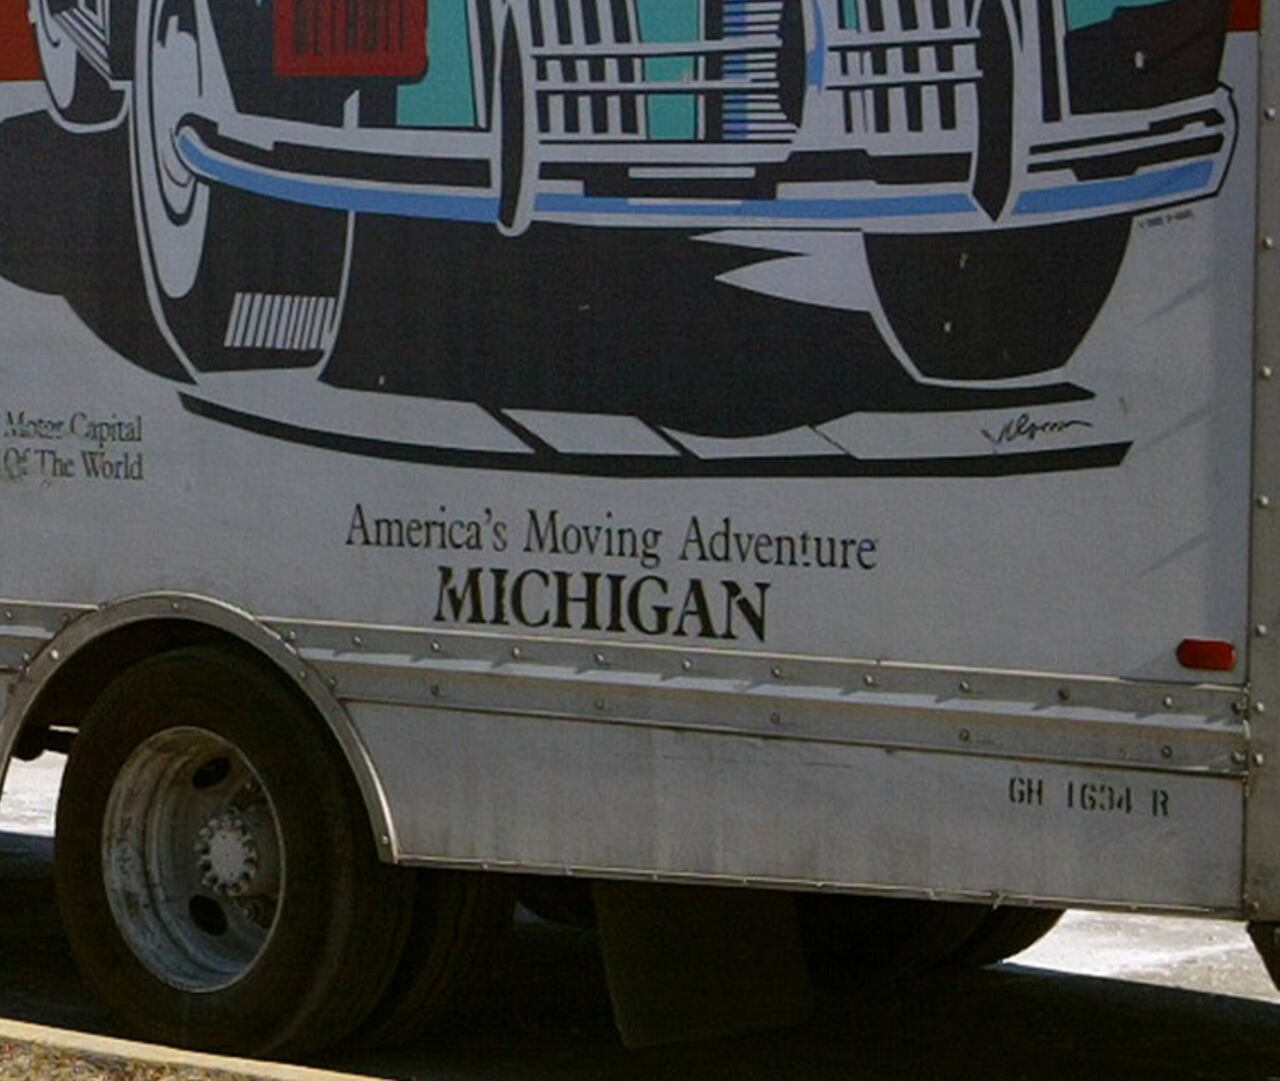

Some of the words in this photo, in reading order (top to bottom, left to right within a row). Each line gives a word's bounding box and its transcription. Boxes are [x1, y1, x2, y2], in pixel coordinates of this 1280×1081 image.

[70, 411, 142, 448] Capital
[3, 446, 31, 479] Of
[34, 449, 75, 478] The
[80, 450, 144, 480] World
[345, 503, 507, 552] America's
[523, 509, 662, 569] Moving
[679, 516, 880, 570] Adventure
[432, 565, 772, 643] MICHIGAN
[1067, 781, 1133, 814] 1634
[1151, 789, 1169, 817] R
